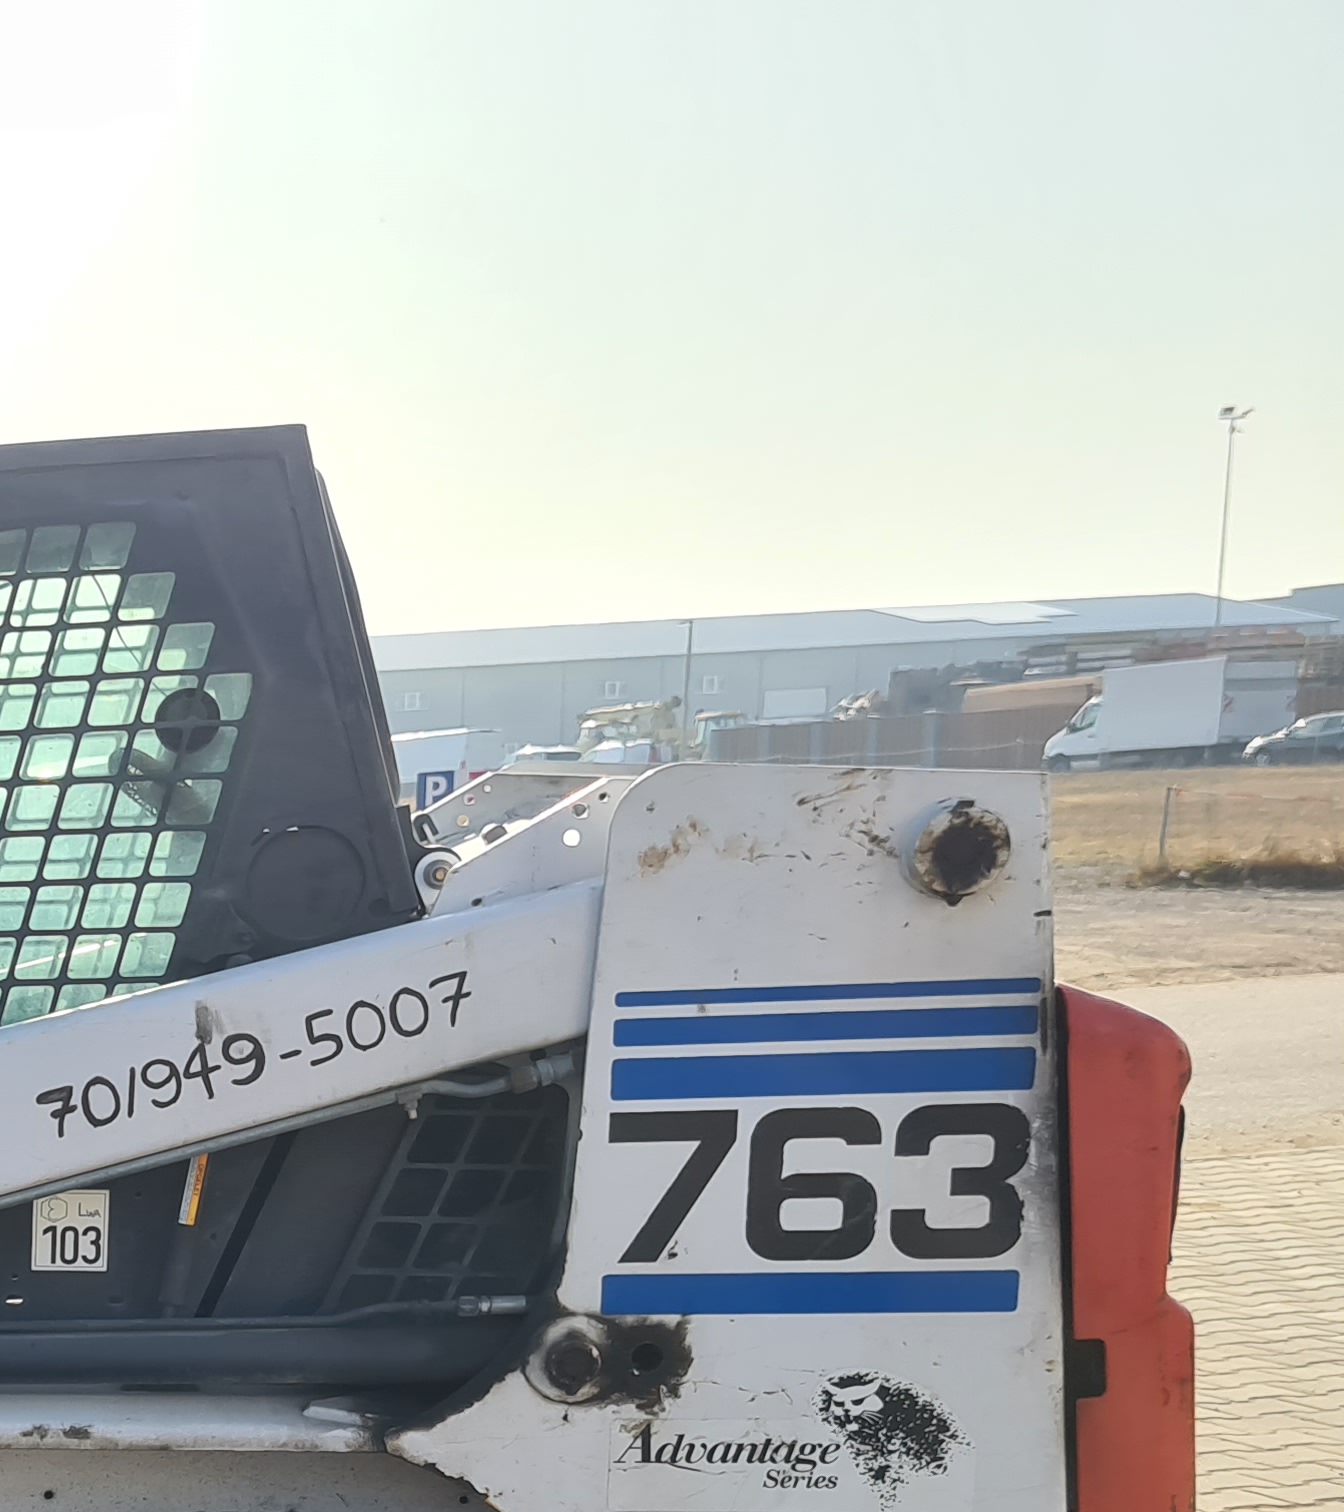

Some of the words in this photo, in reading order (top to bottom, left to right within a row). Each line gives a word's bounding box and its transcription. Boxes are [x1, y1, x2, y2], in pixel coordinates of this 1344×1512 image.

[425, 775, 447, 806] P
[608, 1102, 1031, 1264] 763
[42, 1225, 102, 1265] 103
[612, 1422, 842, 1474] Advantage
[762, 1468, 839, 1490] Series
